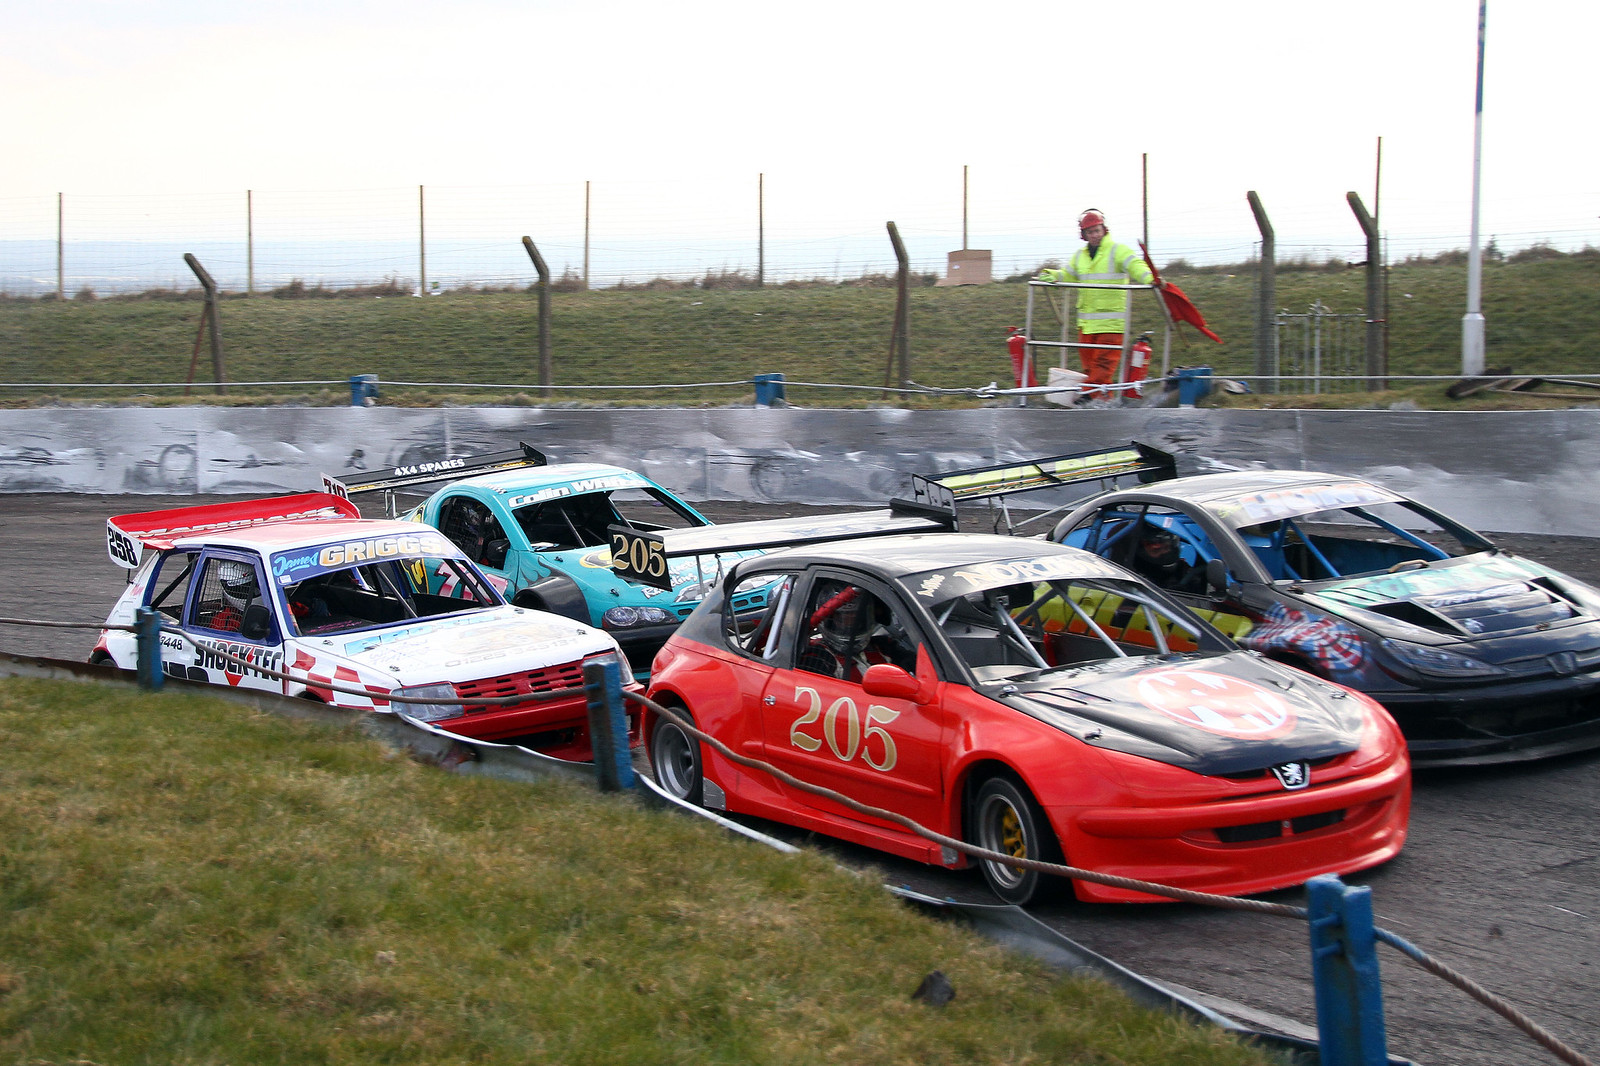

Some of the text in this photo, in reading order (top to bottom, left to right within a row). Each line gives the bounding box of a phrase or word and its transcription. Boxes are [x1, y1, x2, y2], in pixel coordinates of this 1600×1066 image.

[420, 458, 466, 473] SPARES
[508, 486, 571, 508] Colin
[107, 526, 139, 567] 258
[272, 536, 443, 577] James GRIGGS
[612, 534, 666, 578] 205
[790, 686, 901, 772] 205
